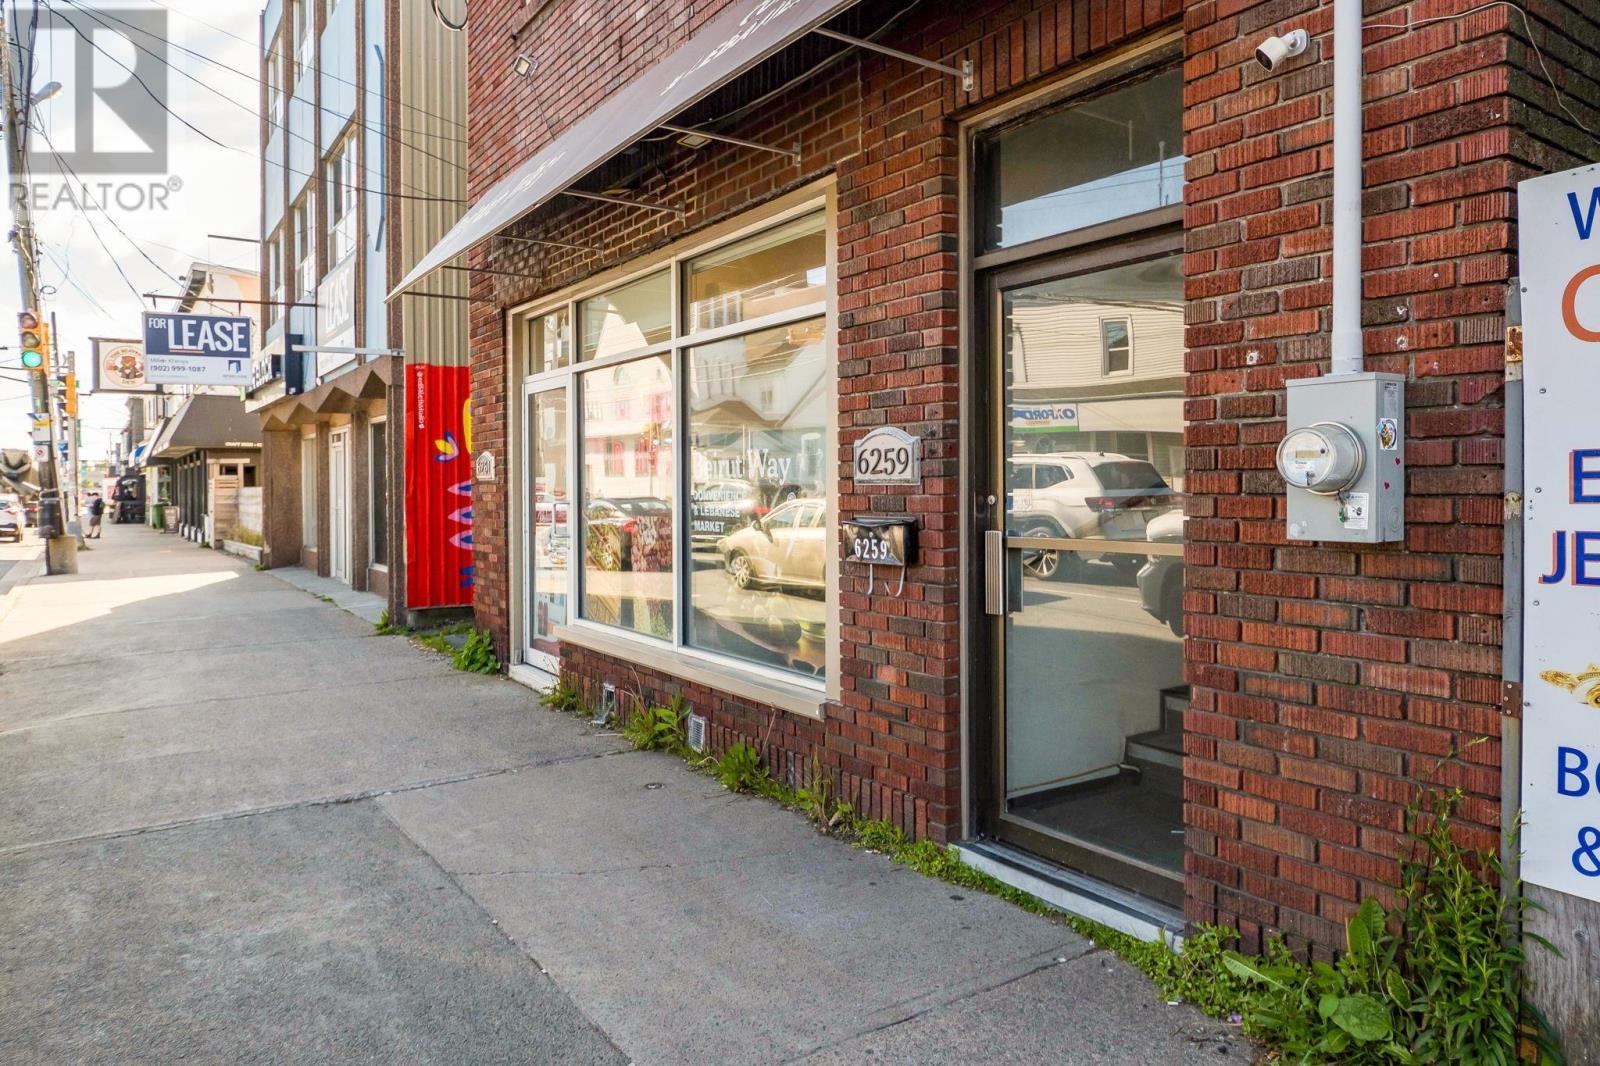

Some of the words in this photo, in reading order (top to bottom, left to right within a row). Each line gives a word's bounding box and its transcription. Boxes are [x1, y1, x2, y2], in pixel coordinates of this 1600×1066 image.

[148, 318, 167, 329] FOR
[168, 319, 247, 352] LEASE
[747, 448, 792, 485] Way
[857, 447, 909, 475] 6259
[700, 505, 741, 518] LEBANESE
[694, 520, 725, 533] MARKET
[854, 538, 888, 560] 6259
